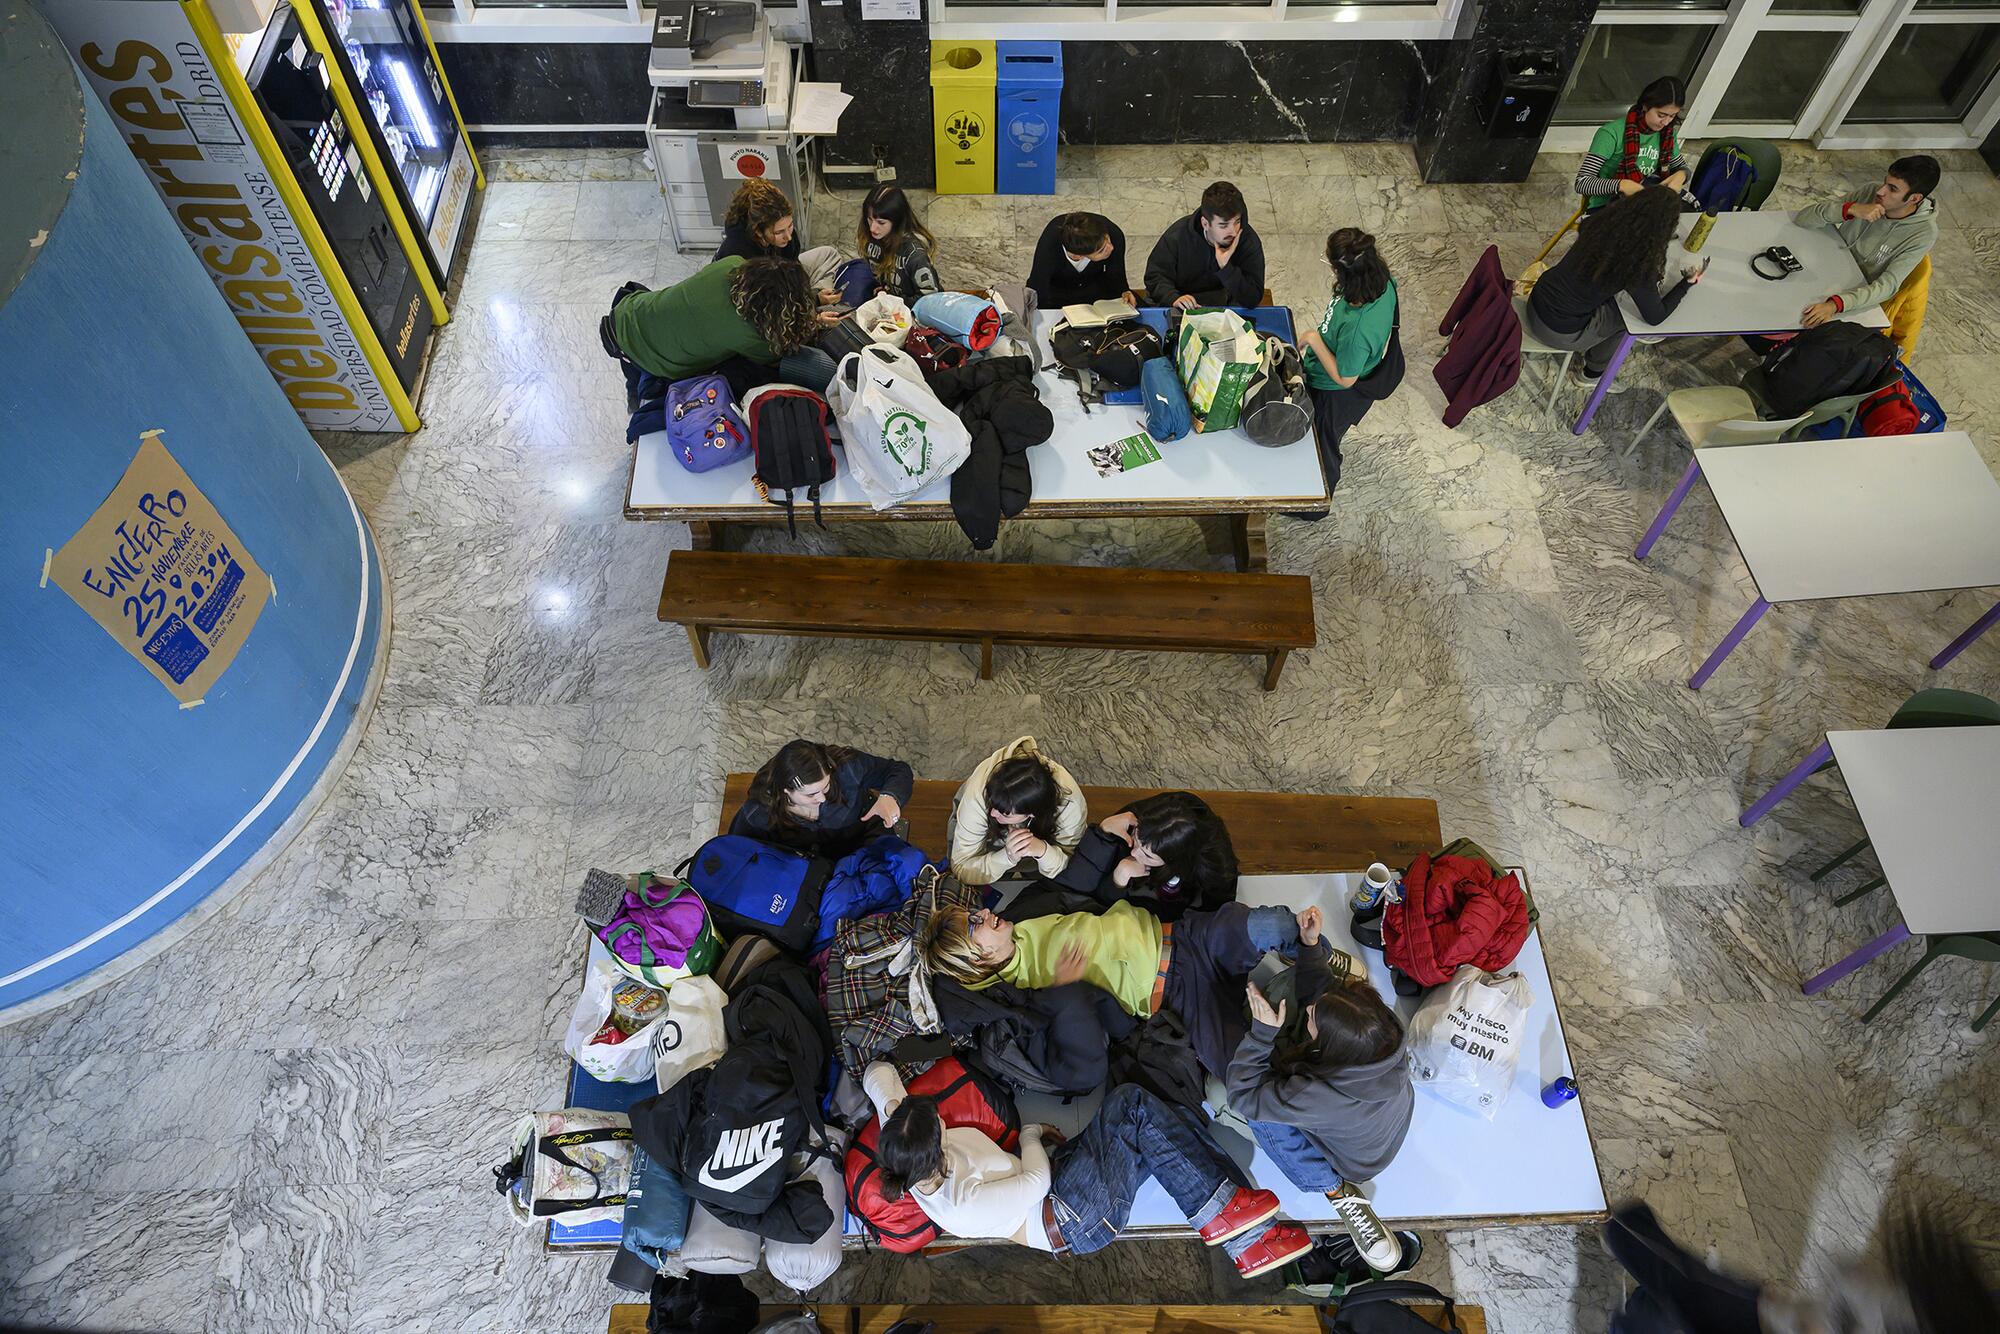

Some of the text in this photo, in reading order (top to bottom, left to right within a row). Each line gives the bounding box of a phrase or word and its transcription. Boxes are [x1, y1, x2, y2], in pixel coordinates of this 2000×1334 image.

[80, 39, 361, 410] bellasartes
[435, 160, 468, 250] bellasartes
[245, 171, 332, 307] COMPLUTENSE
[396, 293, 422, 359] bellasartes
[320, 311, 388, 413] UNIVERSIDAD
[82, 489, 187, 599] ENCIERRO
[151, 521, 196, 584] NOVIEMBRE
[177, 540, 200, 572] FACULTAD
[183, 530, 216, 578] BELLAS ARTES
[123, 578, 167, 638] 25
[147, 617, 185, 656] NECESITAS
[1447, 1013, 1468, 1031] muy
[1467, 1041, 1495, 1062] BM
[710, 1117, 785, 1171] NIKE
